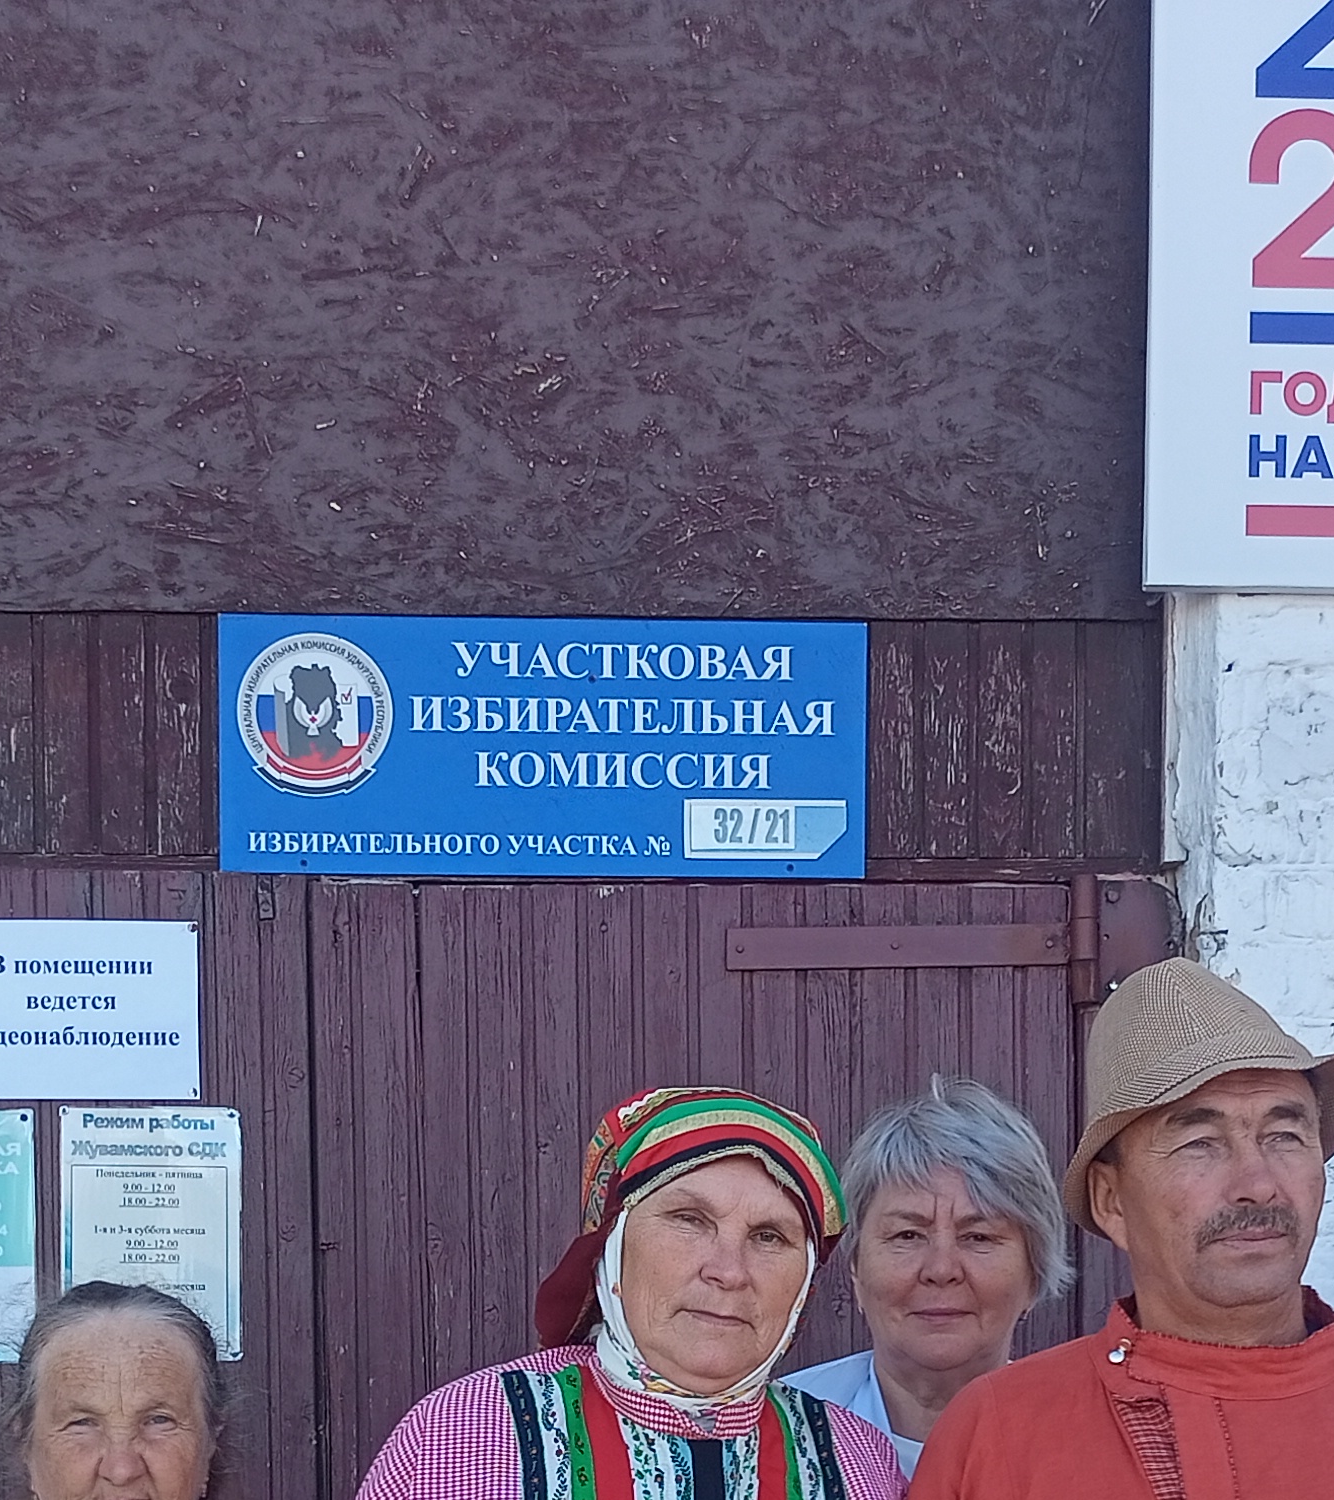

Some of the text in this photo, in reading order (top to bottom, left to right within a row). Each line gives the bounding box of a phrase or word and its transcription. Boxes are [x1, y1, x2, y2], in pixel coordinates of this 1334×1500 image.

[300, 640, 346, 656] КОМИССИЯ
[451, 641, 794, 681] УЧАСТКОВАЯ
[408, 695, 836, 736] ИЗБИРАТЕЛЬНАЯ
[474, 751, 772, 789] КОМИССИЯ
[247, 831, 500, 855] ИЗБИРАТЕЛЬНОГО
[507, 834, 638, 857] УЧАСТКА
[643, 835, 671, 857] №
[14, 960, 153, 976] помещении
[26, 995, 117, 1012] ведется
[83, 1113, 215, 1133] Режим работы
[71, 1140, 227, 1160] Жувамского СДК
[96, 1169, 157, 1179] Понедельник
[165, 1171, 203, 1179] пятница
[123, 1183, 142, 1192] 9.00
[151, 1184, 176, 1193] 12.00
[122, 1197, 146, 1206] 18.00
[155, 1197, 180, 1206] 22.00
[135, 1225, 171, 1236] суббота
[173, 1228, 206, 1236] месяца
[126, 1240, 145, 1249] 9.00
[154, 1240, 179, 1249] 12.00
[123, 1253, 147, 1262] 18.00
[155, 1254, 180, 1263] 22.00
